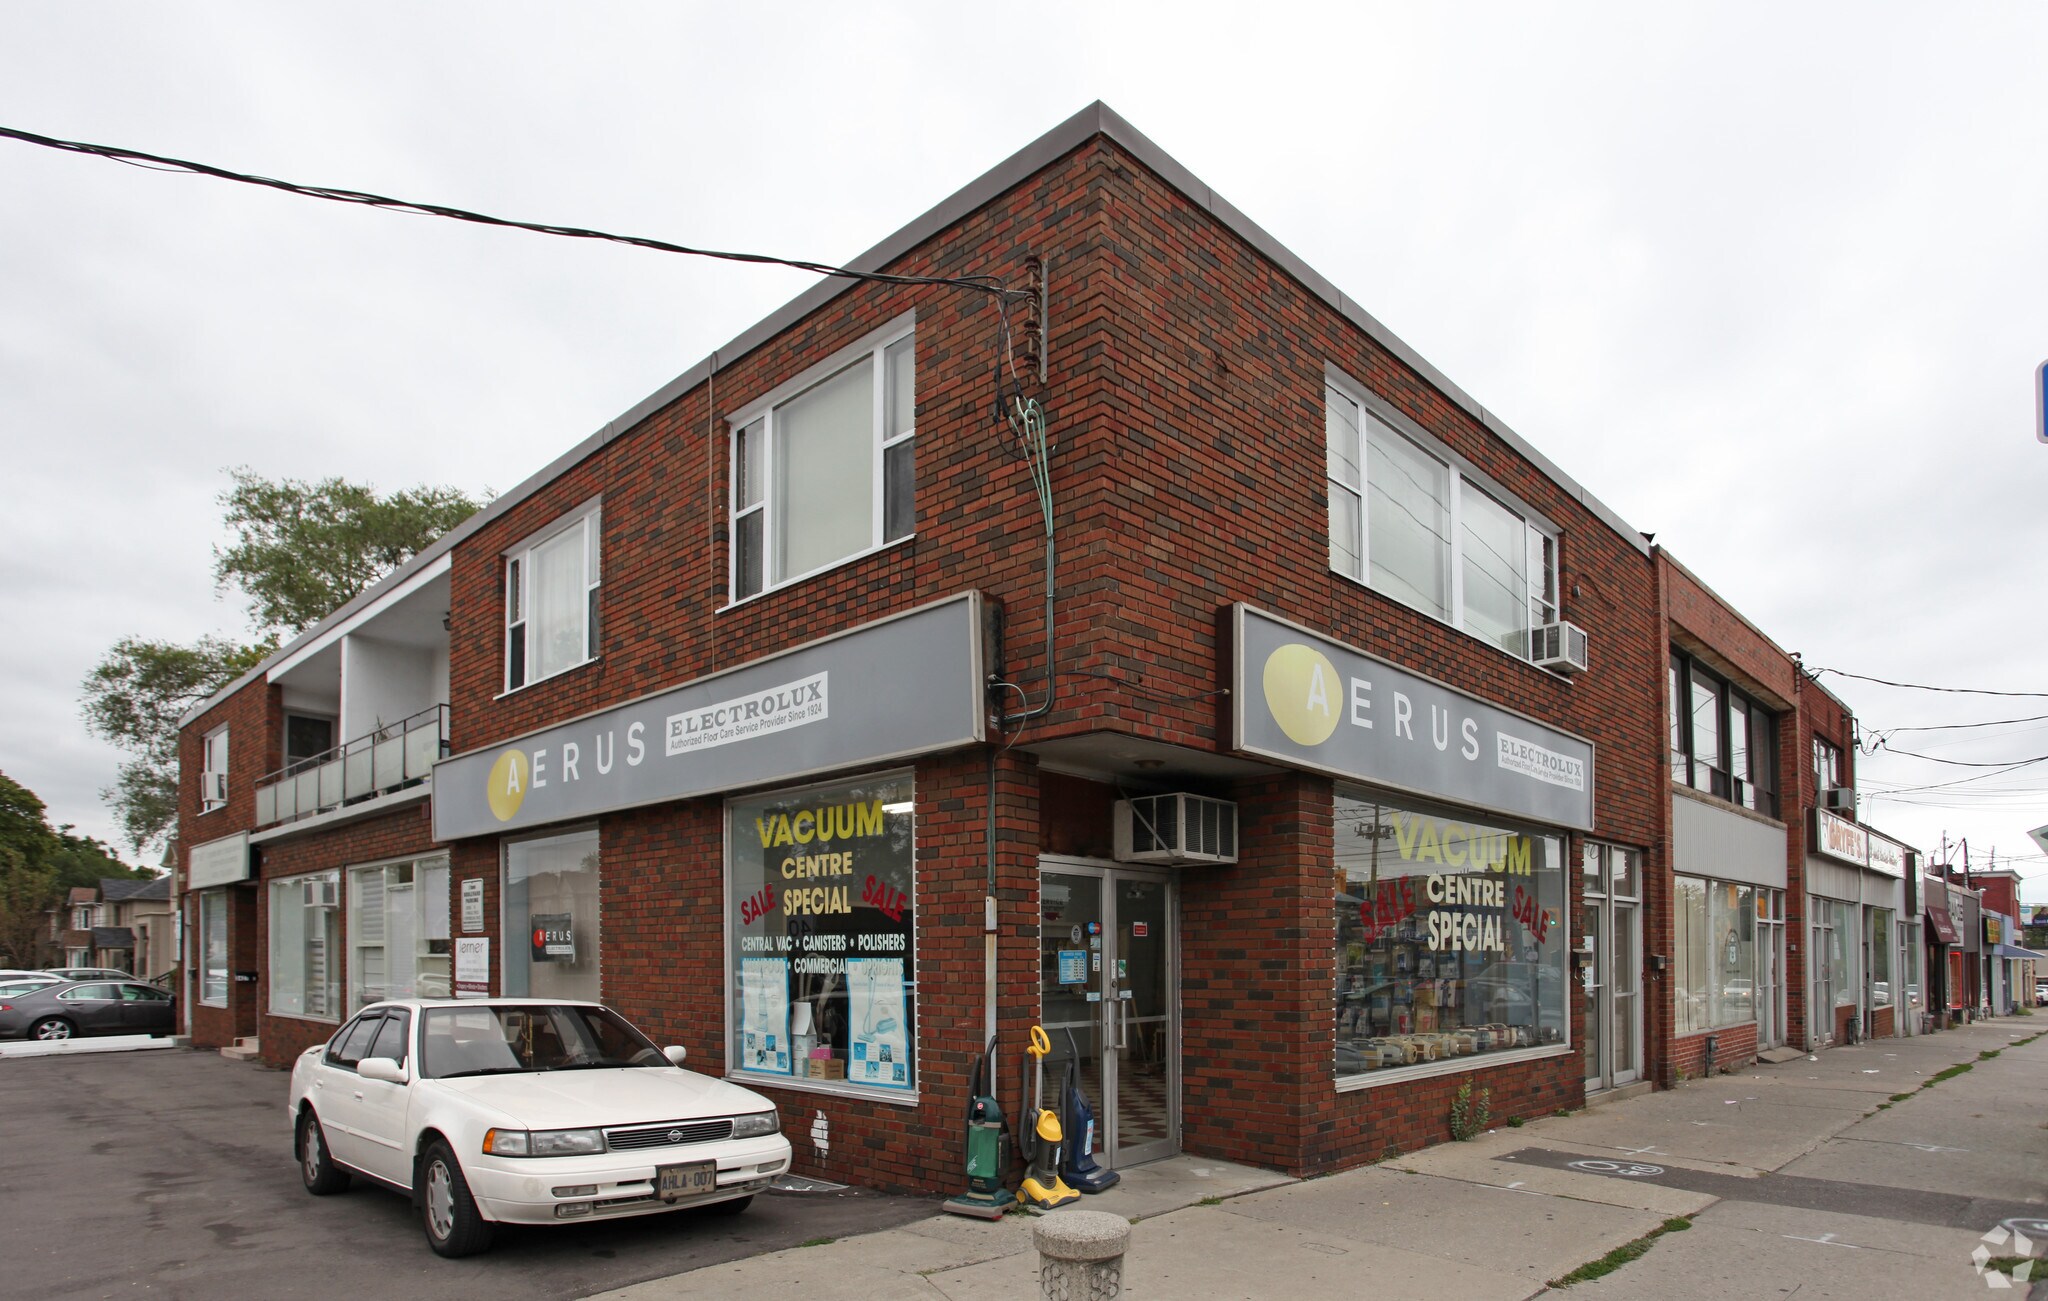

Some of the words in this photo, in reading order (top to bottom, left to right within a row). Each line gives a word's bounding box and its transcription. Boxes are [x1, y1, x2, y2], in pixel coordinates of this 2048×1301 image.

[670, 680, 823, 738] ELECTROLUX
[671, 733, 703, 750] Authorized
[704, 731, 718, 743] Floor
[720, 728, 734, 740] Care
[735, 723, 758, 736] Service
[760, 714, 786, 730] Provider
[789, 710, 805, 722] Since
[807, 702, 822, 717] 1924
[1307, 663, 1480, 761] AERUS
[507, 721, 646, 796] AERUS
[1500, 738, 1581, 777] ELECTROLUX
[756, 799, 884, 849] VACUUM
[1392, 811, 1531, 876] VACUUM
[781, 851, 853, 880] CENTRE
[741, 884, 776, 926] SALE
[783, 886, 852, 917] SPECIAL
[861, 874, 908, 923] SALE
[1359, 873, 1417, 945] SALE
[1426, 872, 1504, 908] CENTRE
[1427, 911, 1505, 952] SPECIAL
[1512, 884, 1550, 945] SALE
[459, 941, 484, 954] lerner
[539, 930, 572, 942] AERUS
[741, 935, 773, 952] CENTRAL
[776, 935, 792, 952] VAC
[803, 934, 847, 952] CANISTERS
[858, 933, 905, 951] POLISHERS
[794, 958, 849, 974] COMMERCIAL
[662, 1174, 687, 1191] AHLA
[694, 1171, 713, 1186] 007
